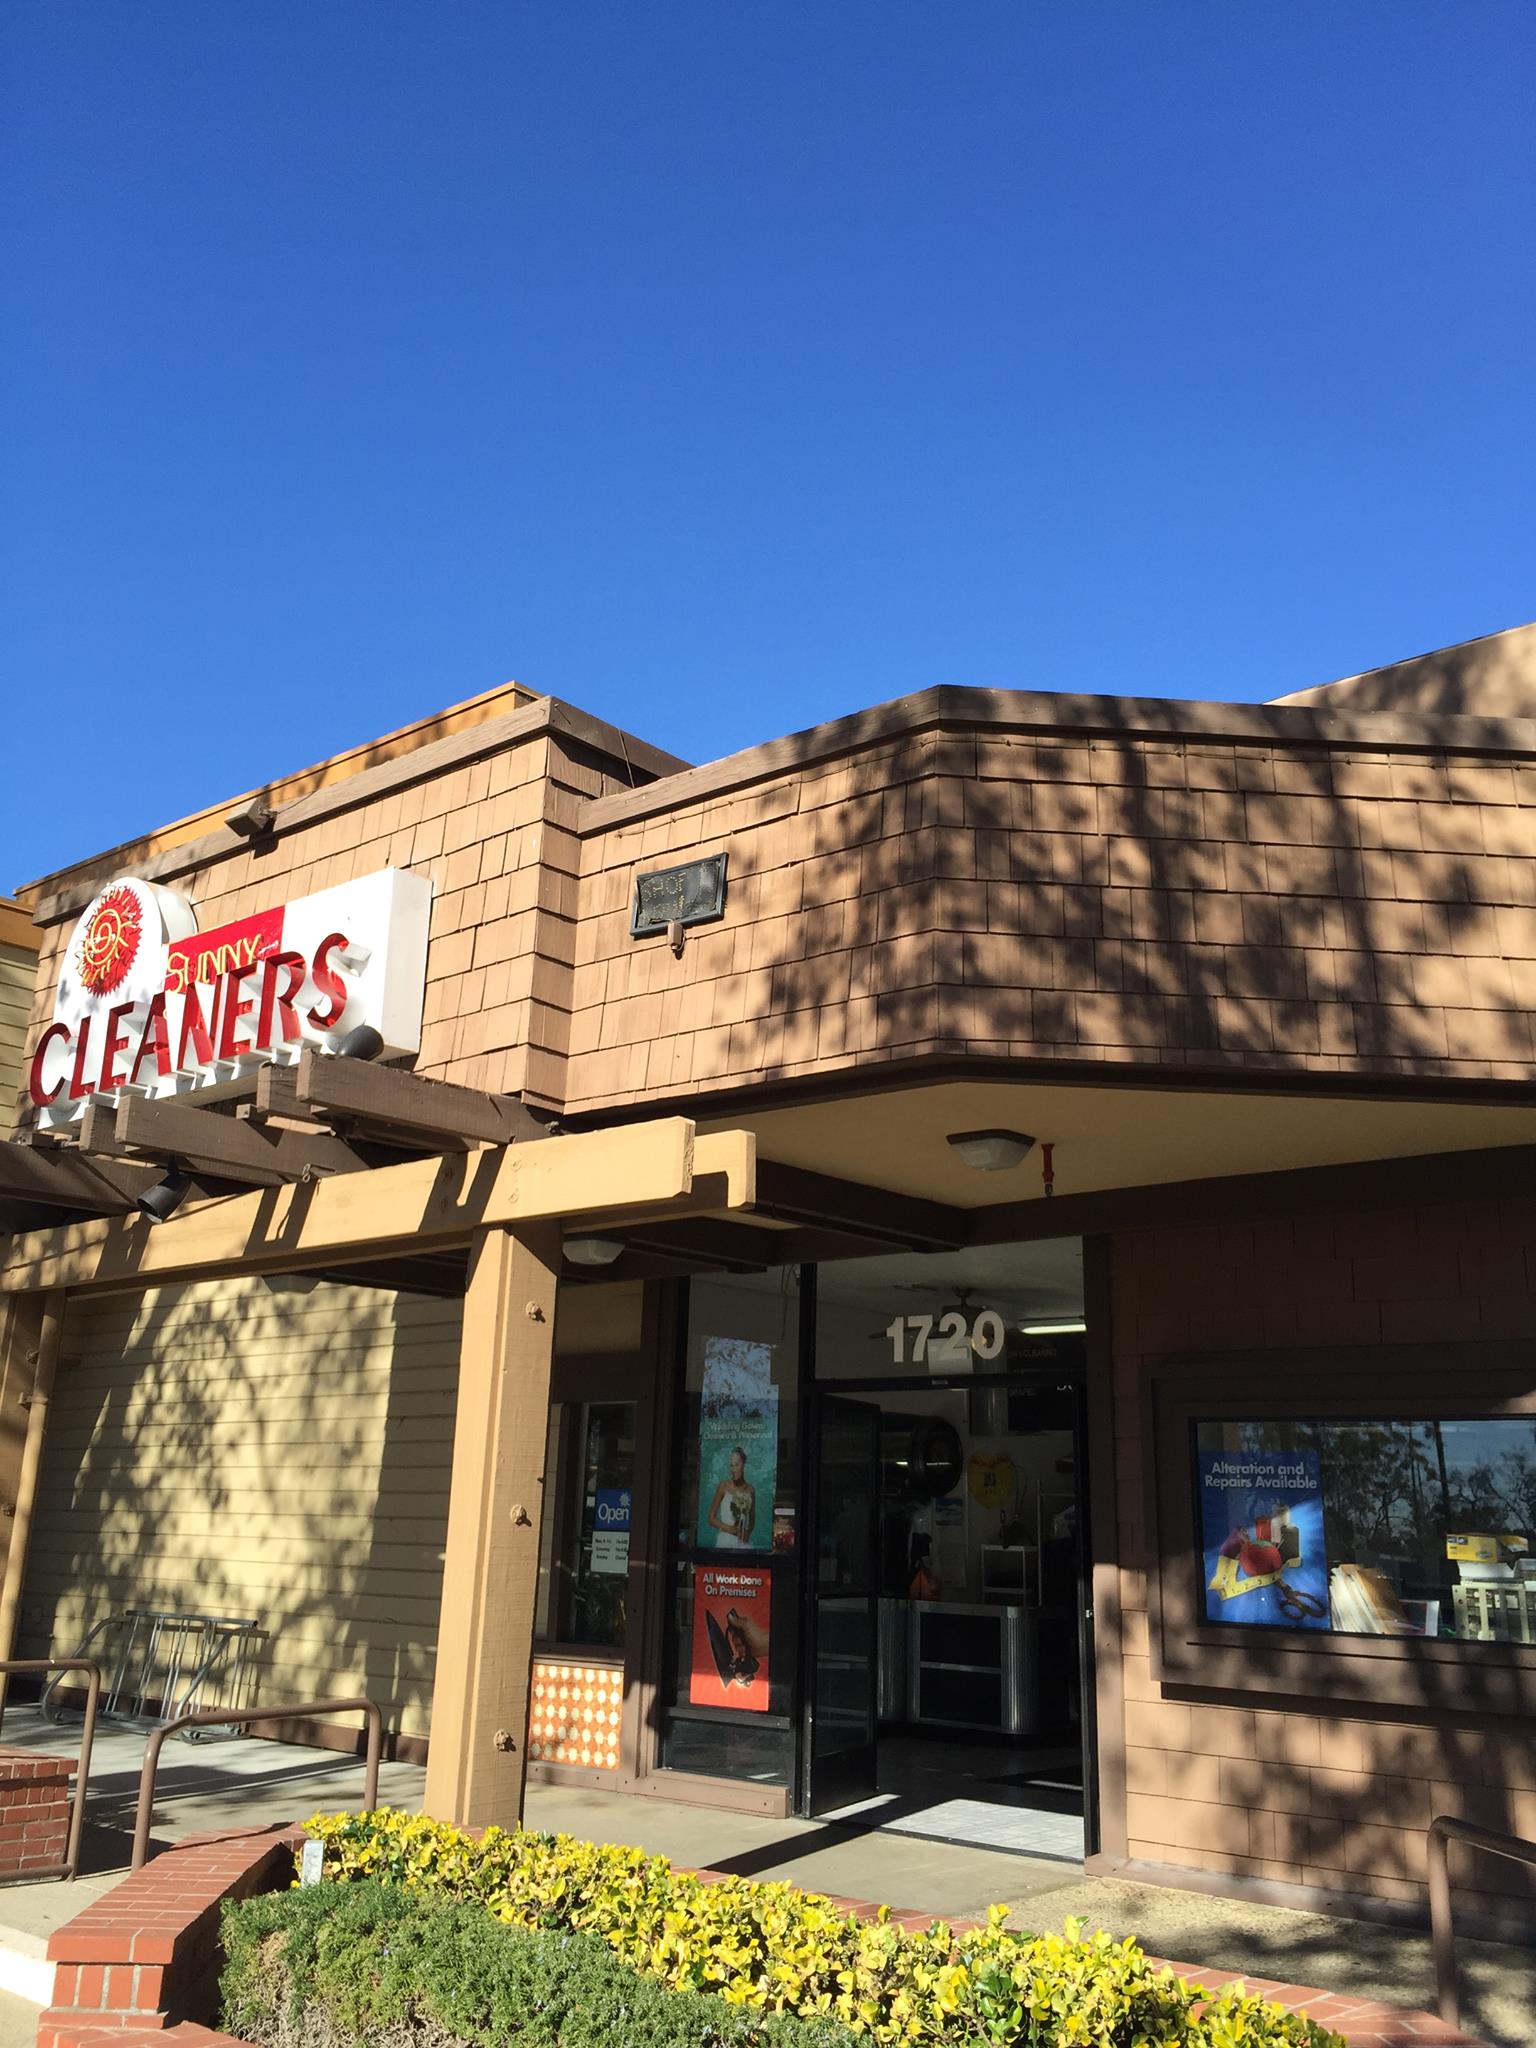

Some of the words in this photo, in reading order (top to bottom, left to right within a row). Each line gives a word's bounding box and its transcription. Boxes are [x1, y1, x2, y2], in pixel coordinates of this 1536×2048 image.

[167, 933, 262, 994] SUNNY
[29, 932, 364, 1107] CLEANERS
[886, 1310, 1005, 1363] 1720
[1211, 1461, 1275, 1475] Alteration
[1277, 1462, 1305, 1475] and
[1204, 1475, 1253, 1490] Repairs
[1254, 1475, 1318, 1489] Available
[598, 1503, 630, 1524] Open
[703, 1572, 714, 1584] All
[715, 1573, 738, 1585] Work
[740, 1574, 762, 1586] Done
[705, 1584, 718, 1595] On
[719, 1585, 757, 1598] Premises
